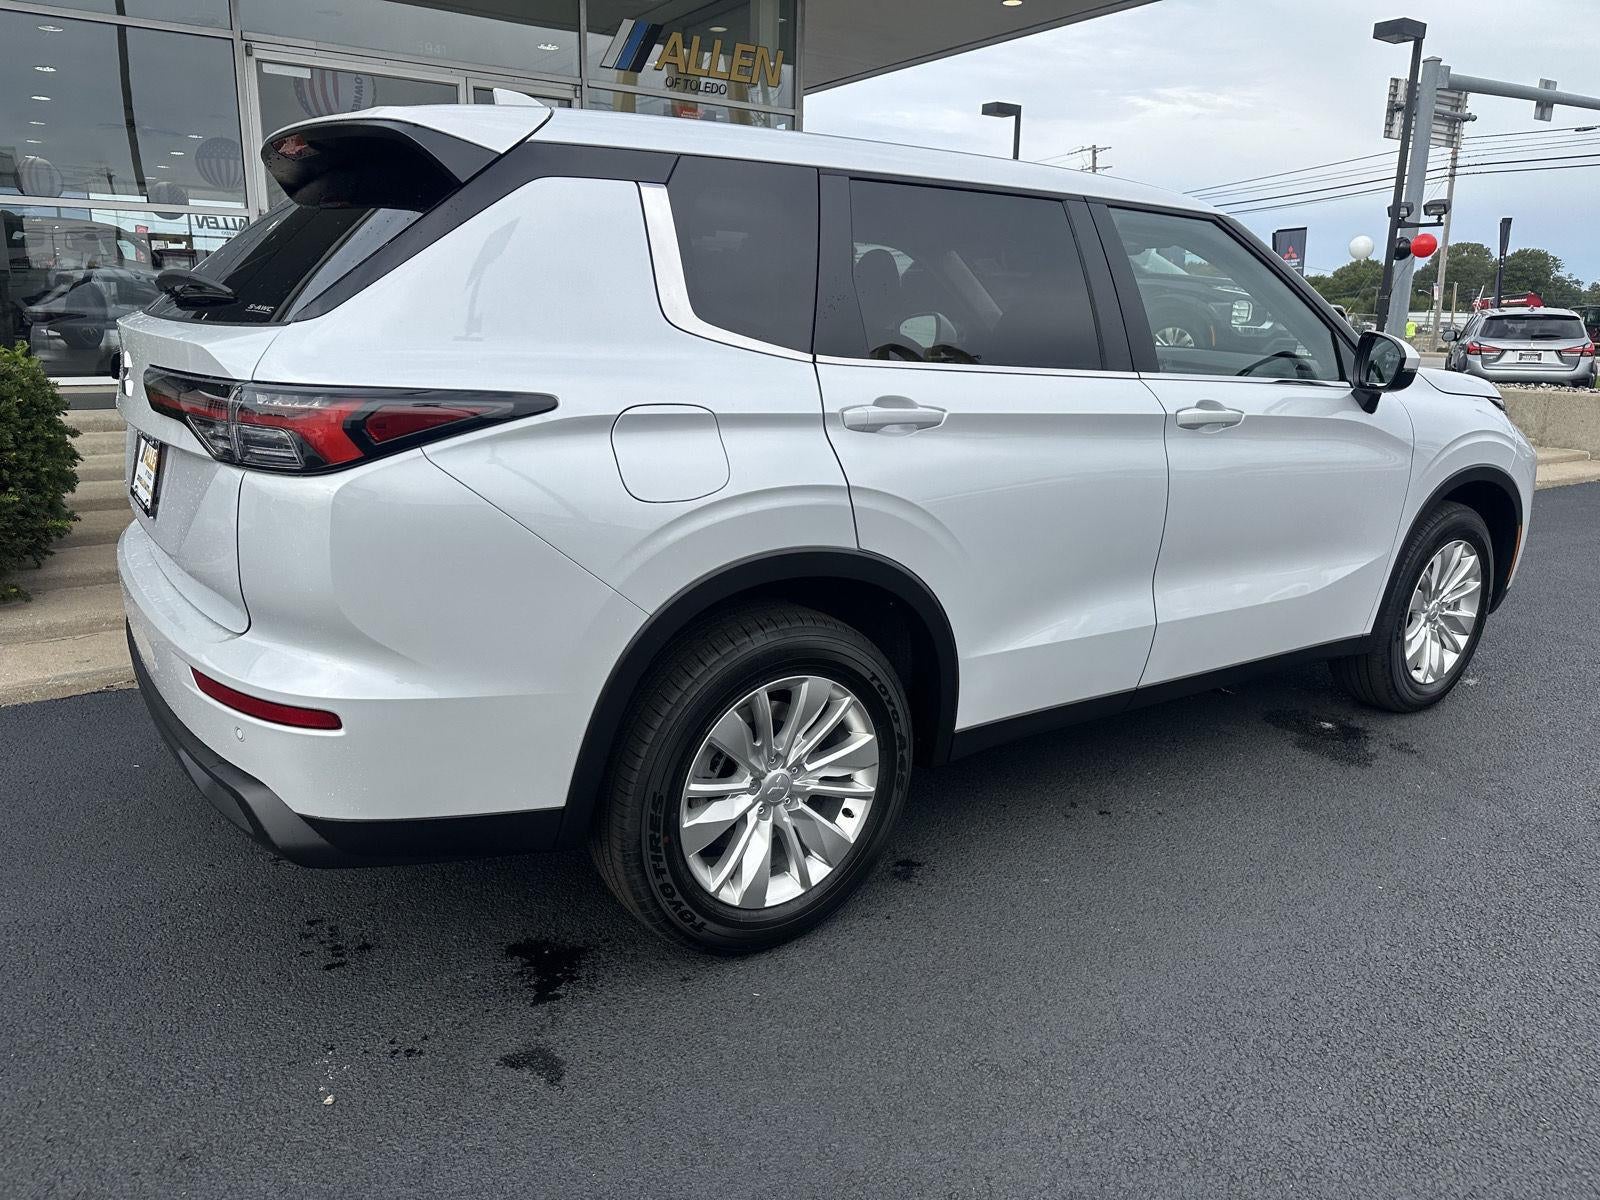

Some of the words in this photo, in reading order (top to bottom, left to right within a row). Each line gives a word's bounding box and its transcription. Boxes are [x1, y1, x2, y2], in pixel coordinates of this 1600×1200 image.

[654, 31, 784, 88] ALLEN
[353, 77, 364, 109] OWNE
[665, 76, 682, 89] OF
[684, 79, 727, 95] TOLEDO
[869, 671, 899, 724] TOYO
[649, 791, 665, 883] TIRES
[658, 882, 707, 932] TOYO
